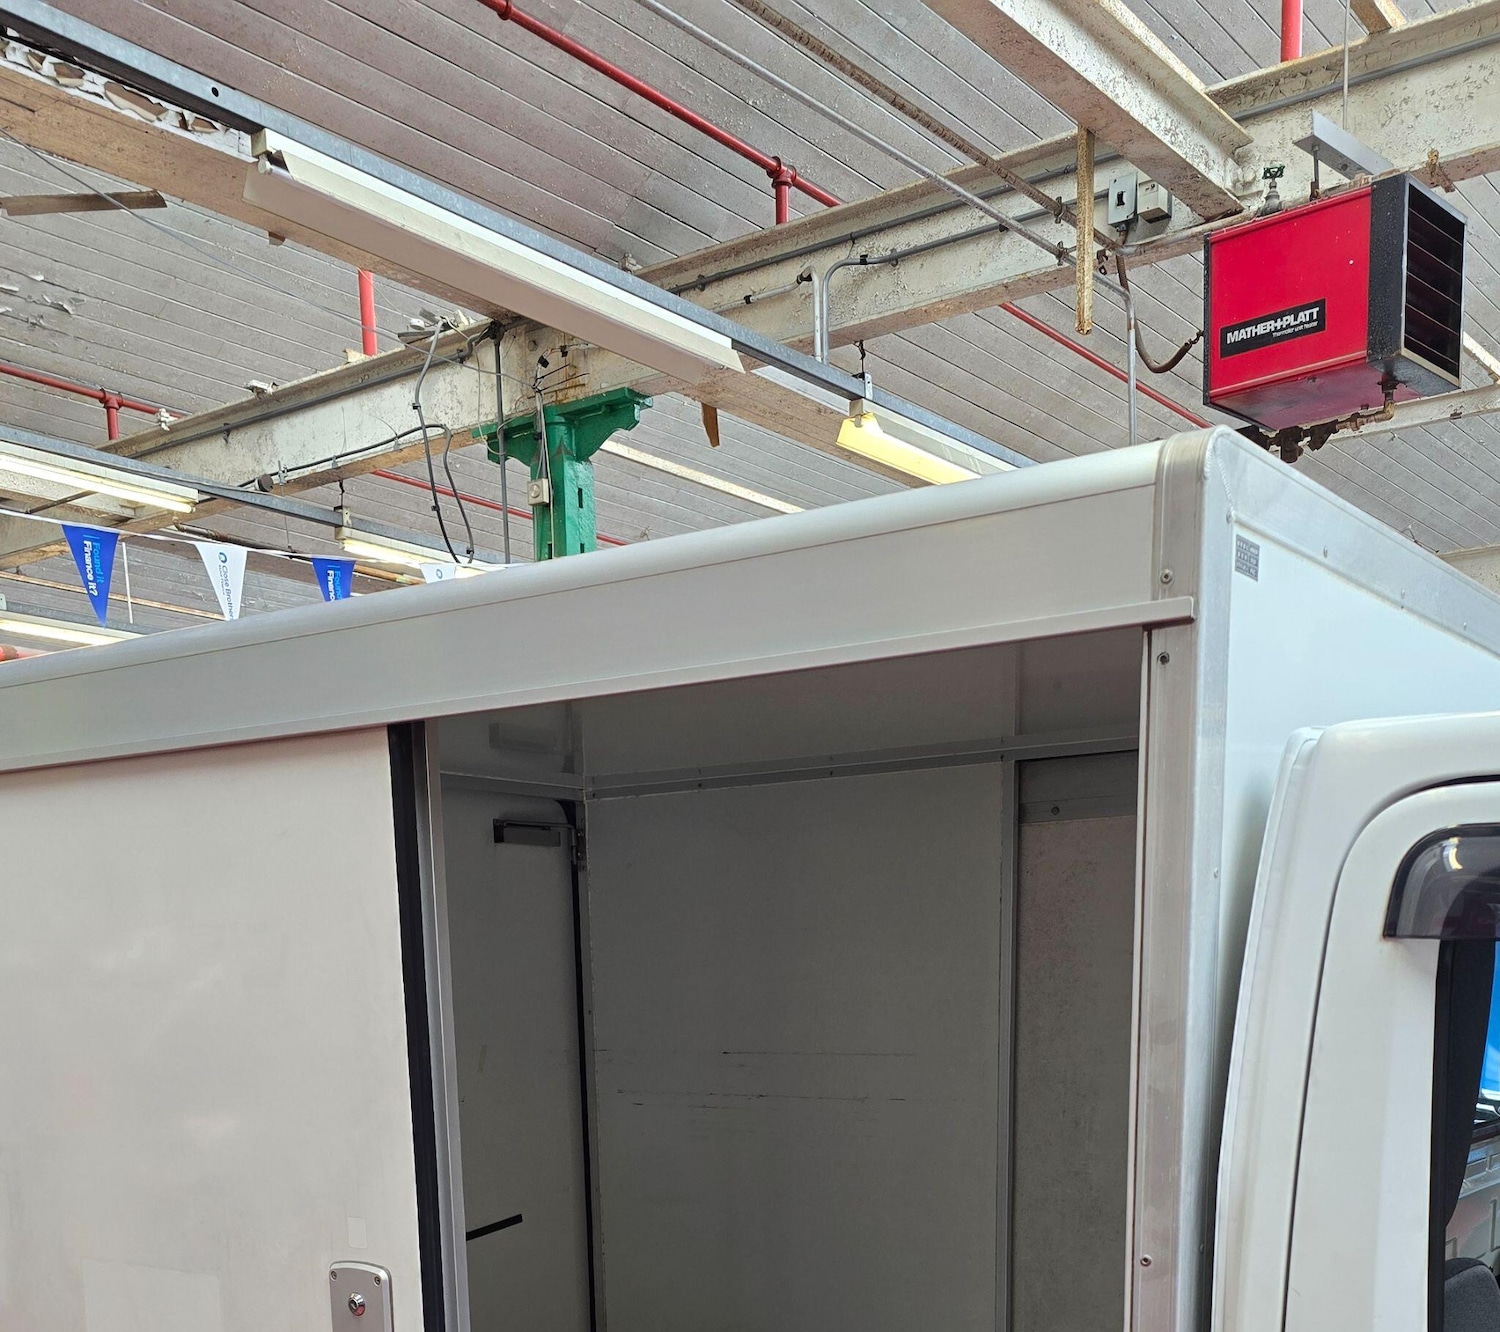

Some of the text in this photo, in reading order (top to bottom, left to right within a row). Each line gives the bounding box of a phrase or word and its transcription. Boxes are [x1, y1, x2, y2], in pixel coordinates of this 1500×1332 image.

[1227, 307, 1319, 344] MATHER+PLATT
[83, 540, 95, 581] Finance
[92, 542, 104, 575] Found
[222, 565, 230, 587] Close
[327, 569, 336, 601] Financ
